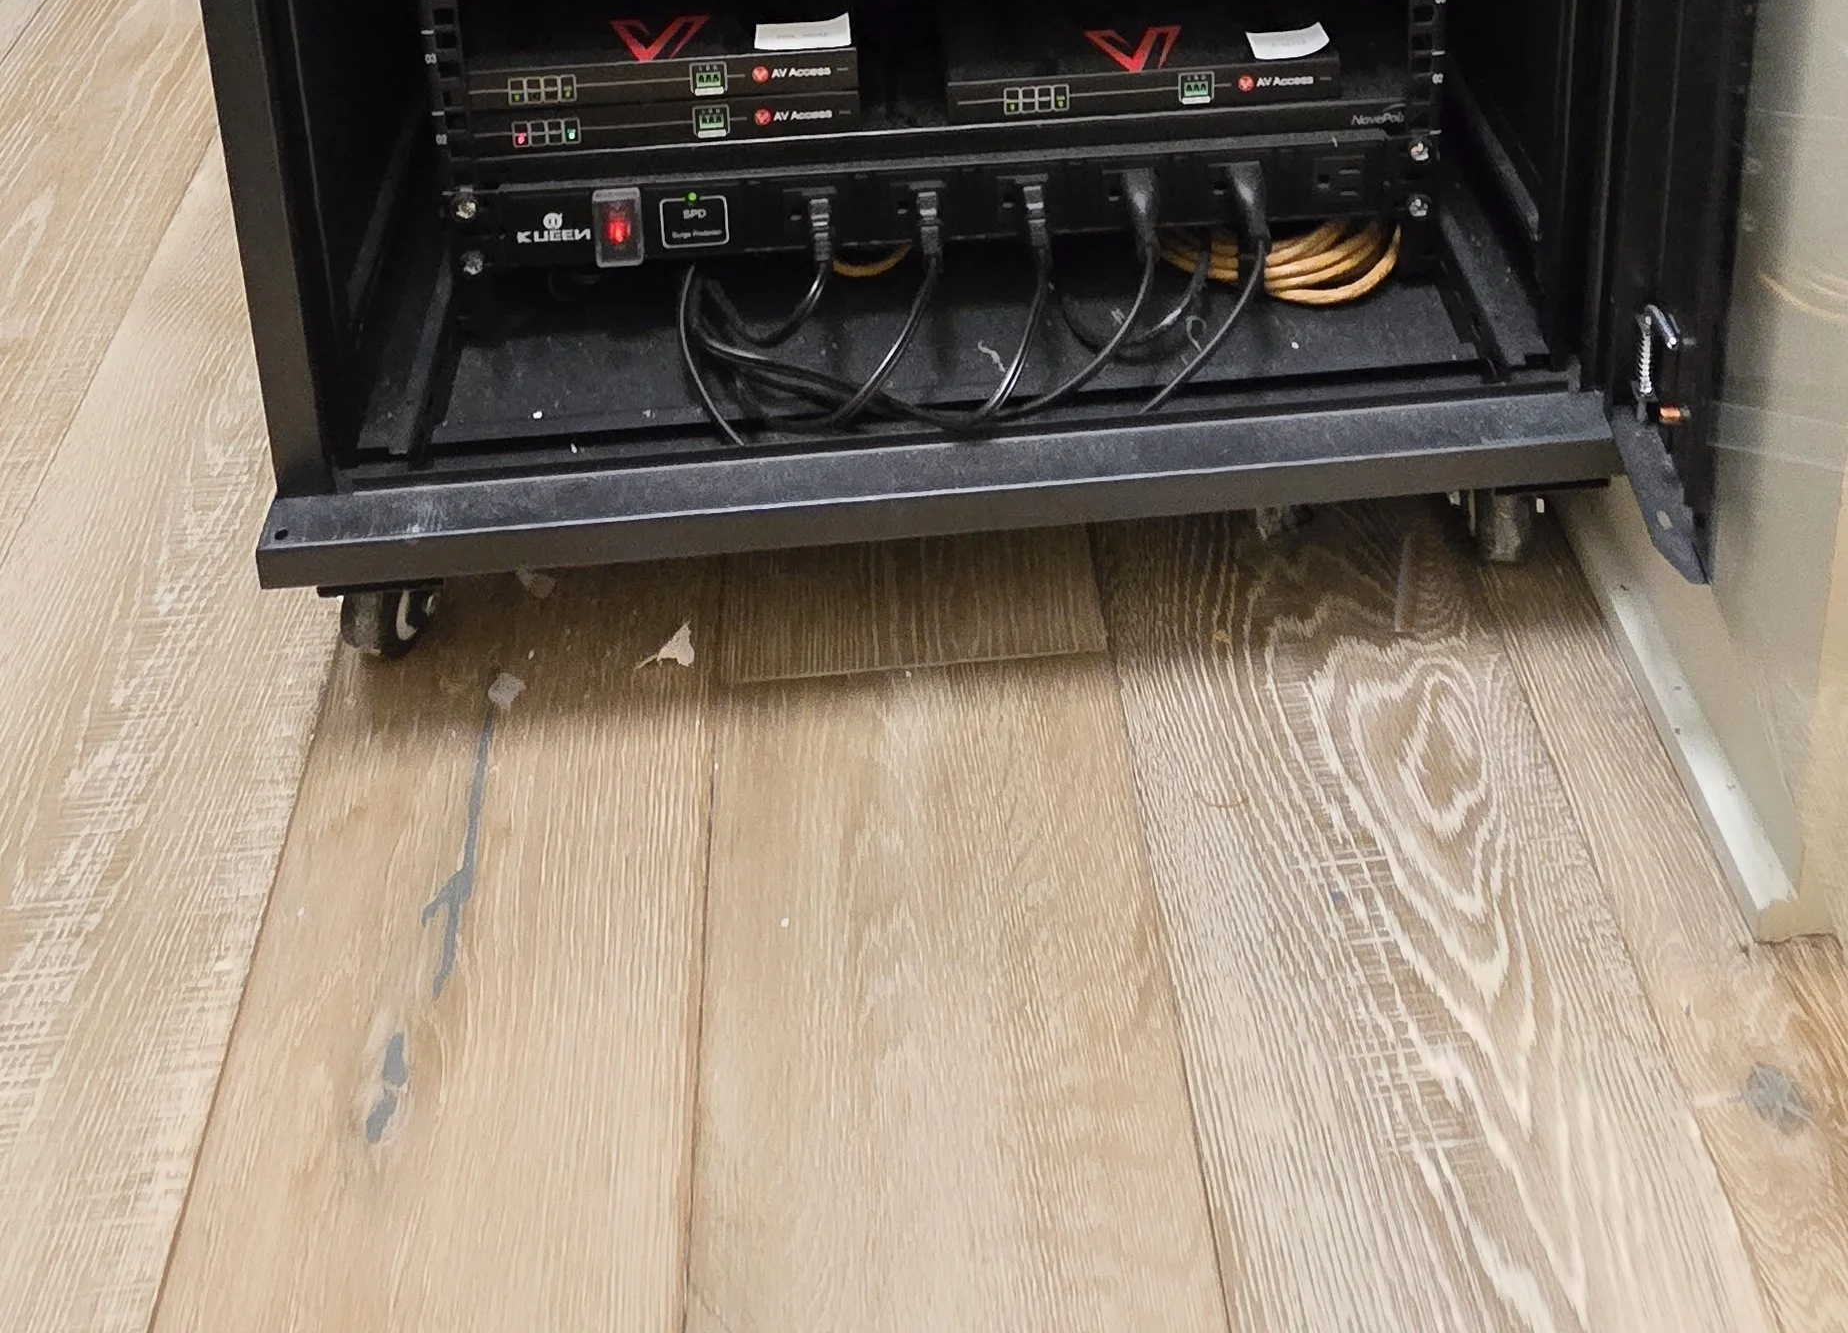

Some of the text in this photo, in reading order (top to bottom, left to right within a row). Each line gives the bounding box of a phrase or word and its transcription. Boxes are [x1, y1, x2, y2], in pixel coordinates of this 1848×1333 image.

[771, 67, 832, 79] AV Access
[1256, 76, 1314, 88] AV Access
[773, 110, 833, 122] AV Access
[683, 209, 707, 220] SPD
[516, 228, 591, 244] KUGEN
